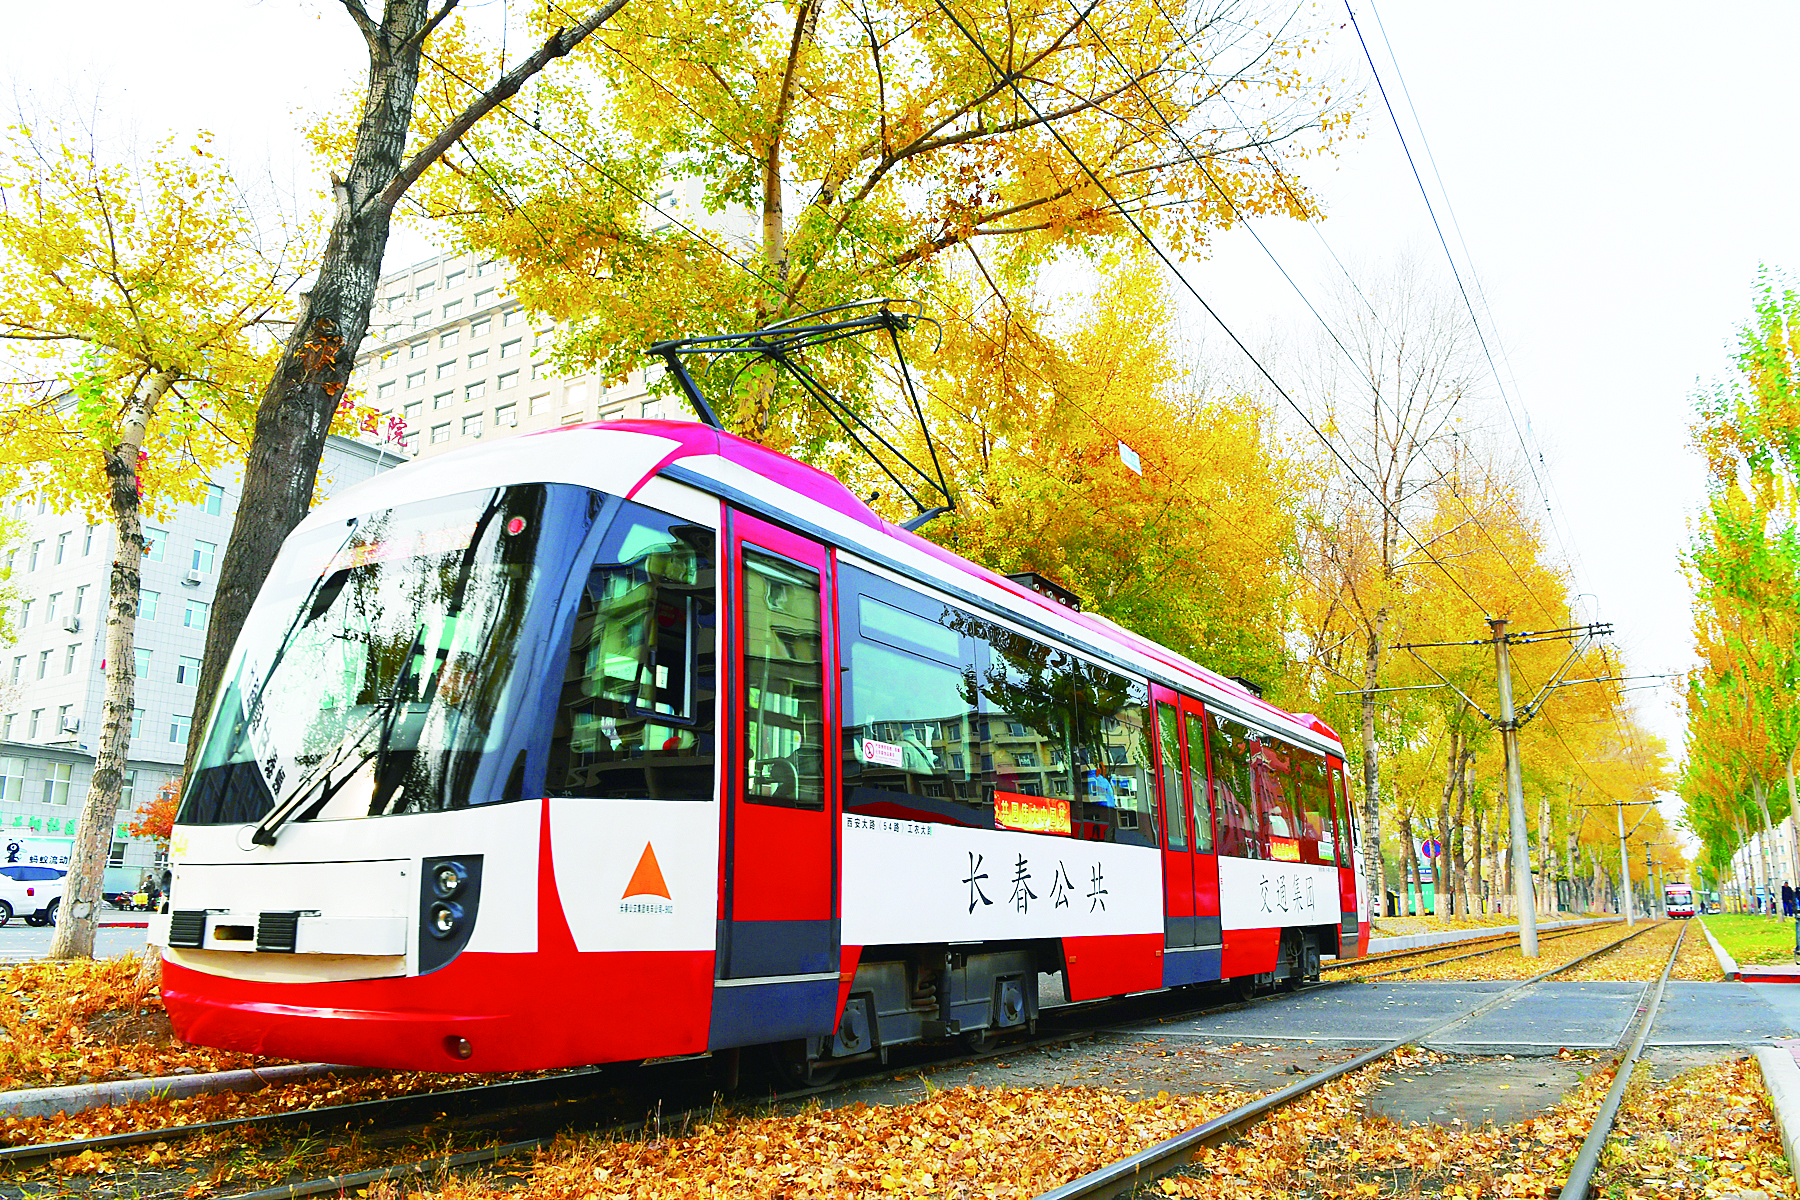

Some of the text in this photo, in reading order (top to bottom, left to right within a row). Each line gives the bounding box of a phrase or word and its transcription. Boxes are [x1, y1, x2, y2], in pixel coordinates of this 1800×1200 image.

[962, 851, 1109, 914] 长春公共
[1259, 873, 1315, 916] 交通集团
